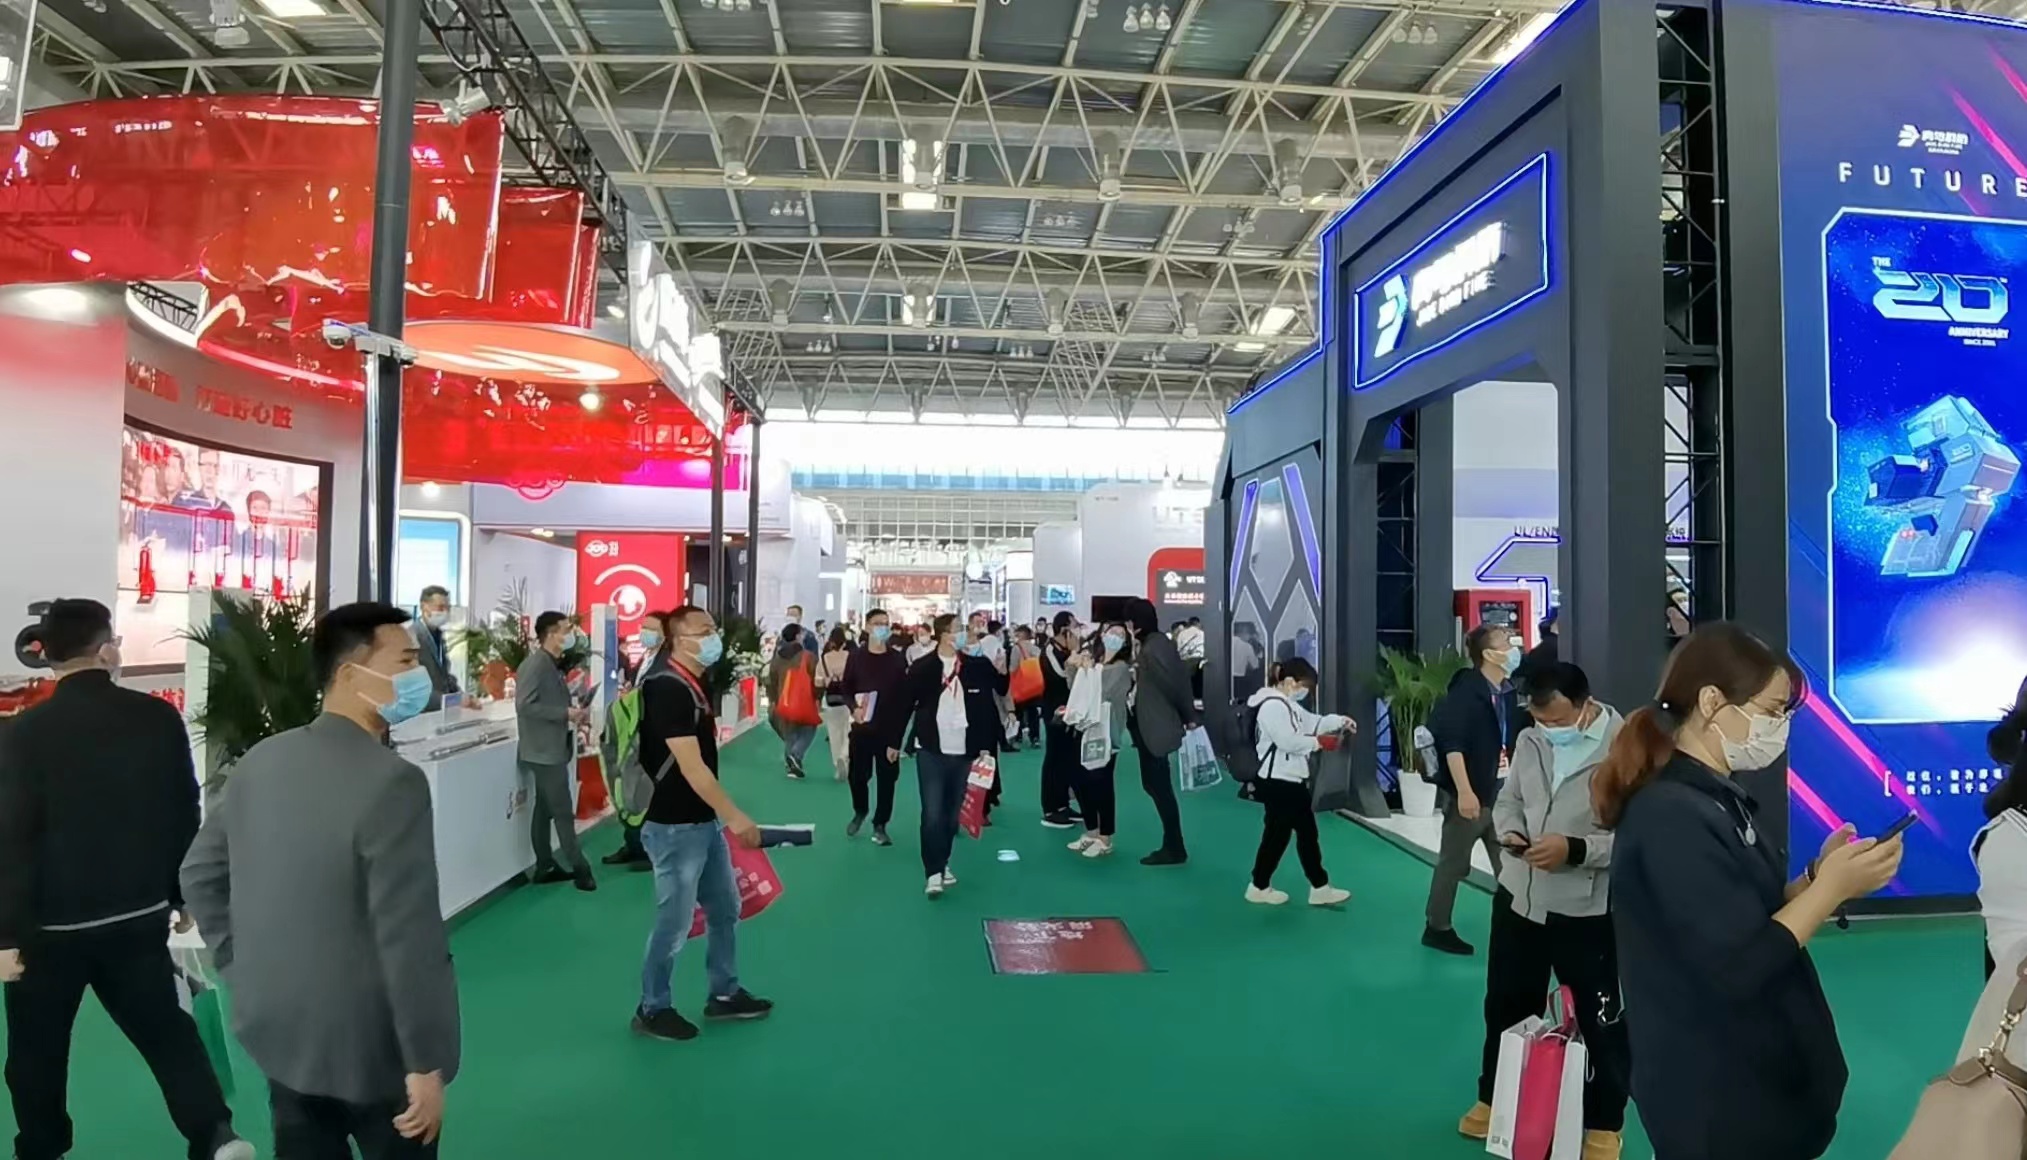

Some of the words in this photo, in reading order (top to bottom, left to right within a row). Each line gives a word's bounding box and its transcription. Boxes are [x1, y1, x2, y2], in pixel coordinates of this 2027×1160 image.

[1839, 162, 2027, 197] FUTURE
[1872, 270, 2008, 324] 20
[1948, 326, 2009, 338] ANNIVERSARY
